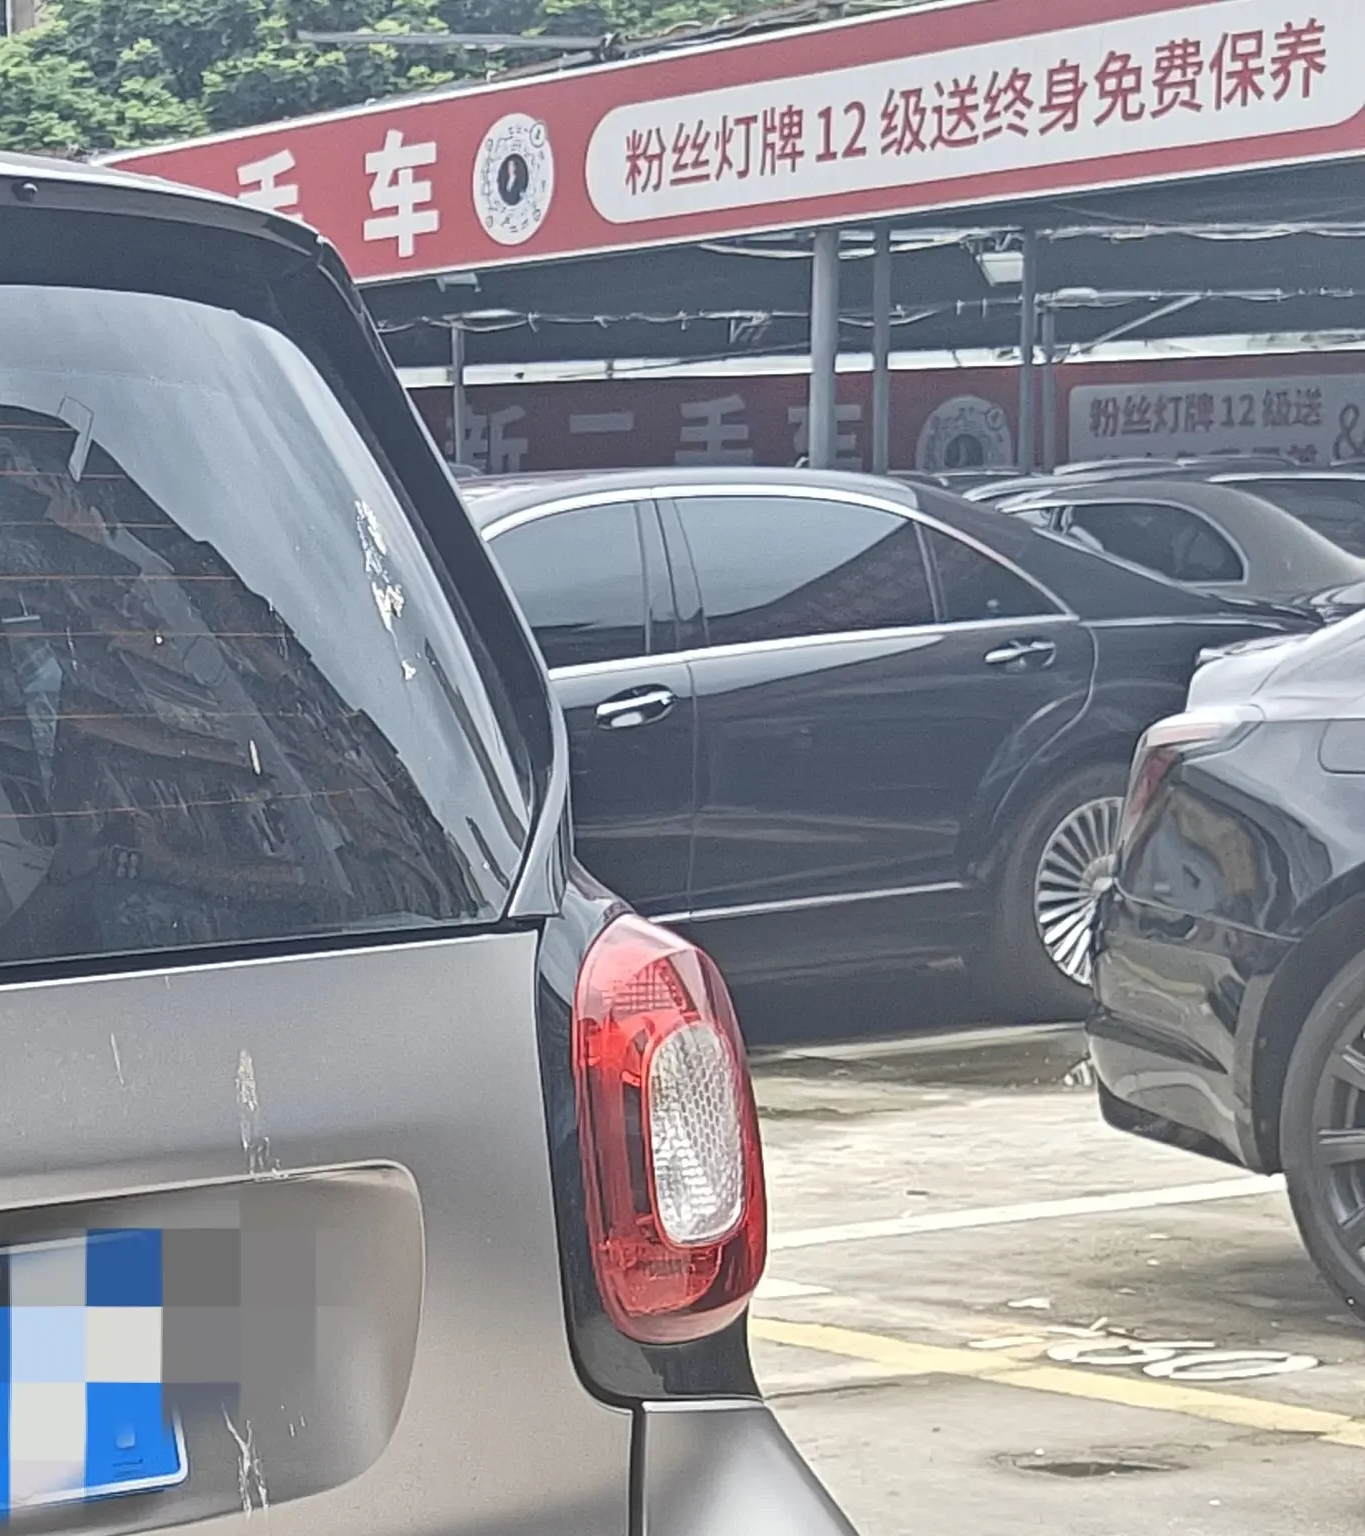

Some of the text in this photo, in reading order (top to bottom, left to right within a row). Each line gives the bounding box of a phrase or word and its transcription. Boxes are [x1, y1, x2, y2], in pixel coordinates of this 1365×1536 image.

[624, 18, 1327, 196] 粉丝灯牌12级送终身免费保养
